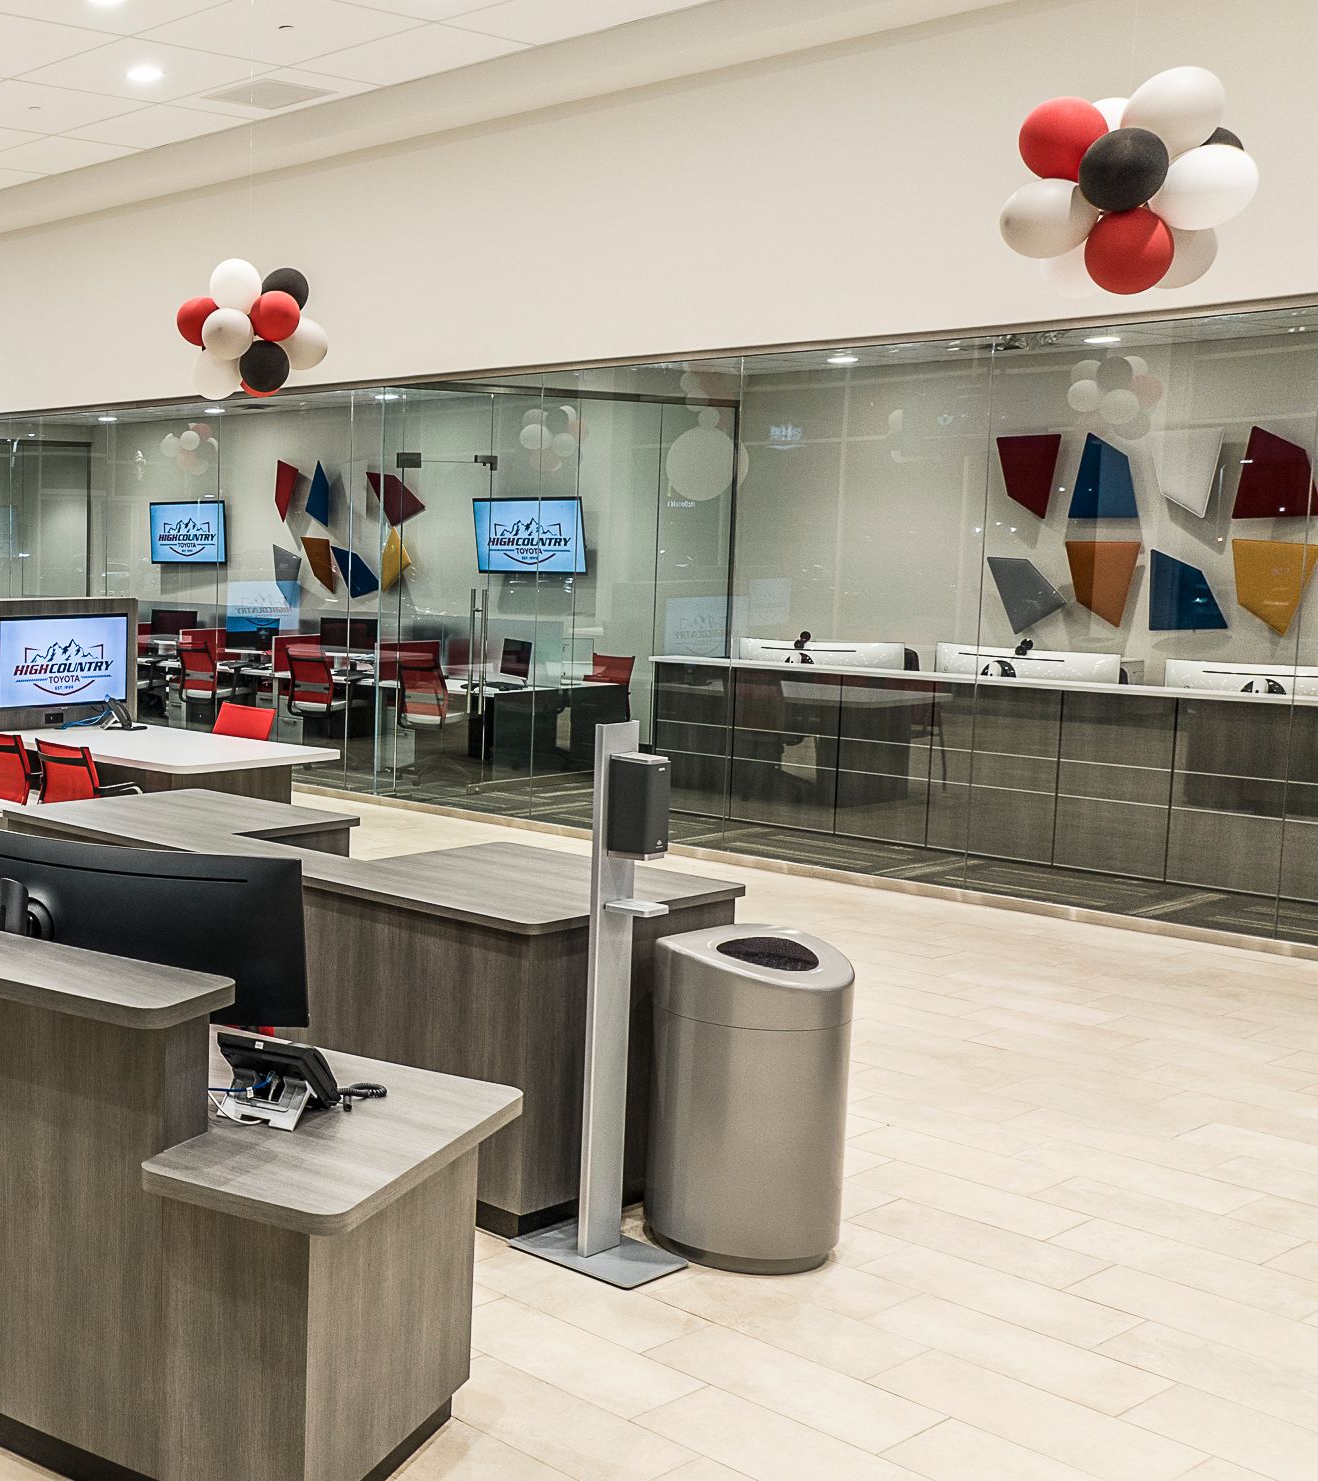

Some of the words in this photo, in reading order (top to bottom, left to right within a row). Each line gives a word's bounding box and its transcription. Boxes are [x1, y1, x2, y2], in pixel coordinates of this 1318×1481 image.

[515, 547, 543, 555] TOYOTA
[13, 660, 114, 676] HIGHCOUNTRY
[48, 675, 81, 684] TOYOTA
